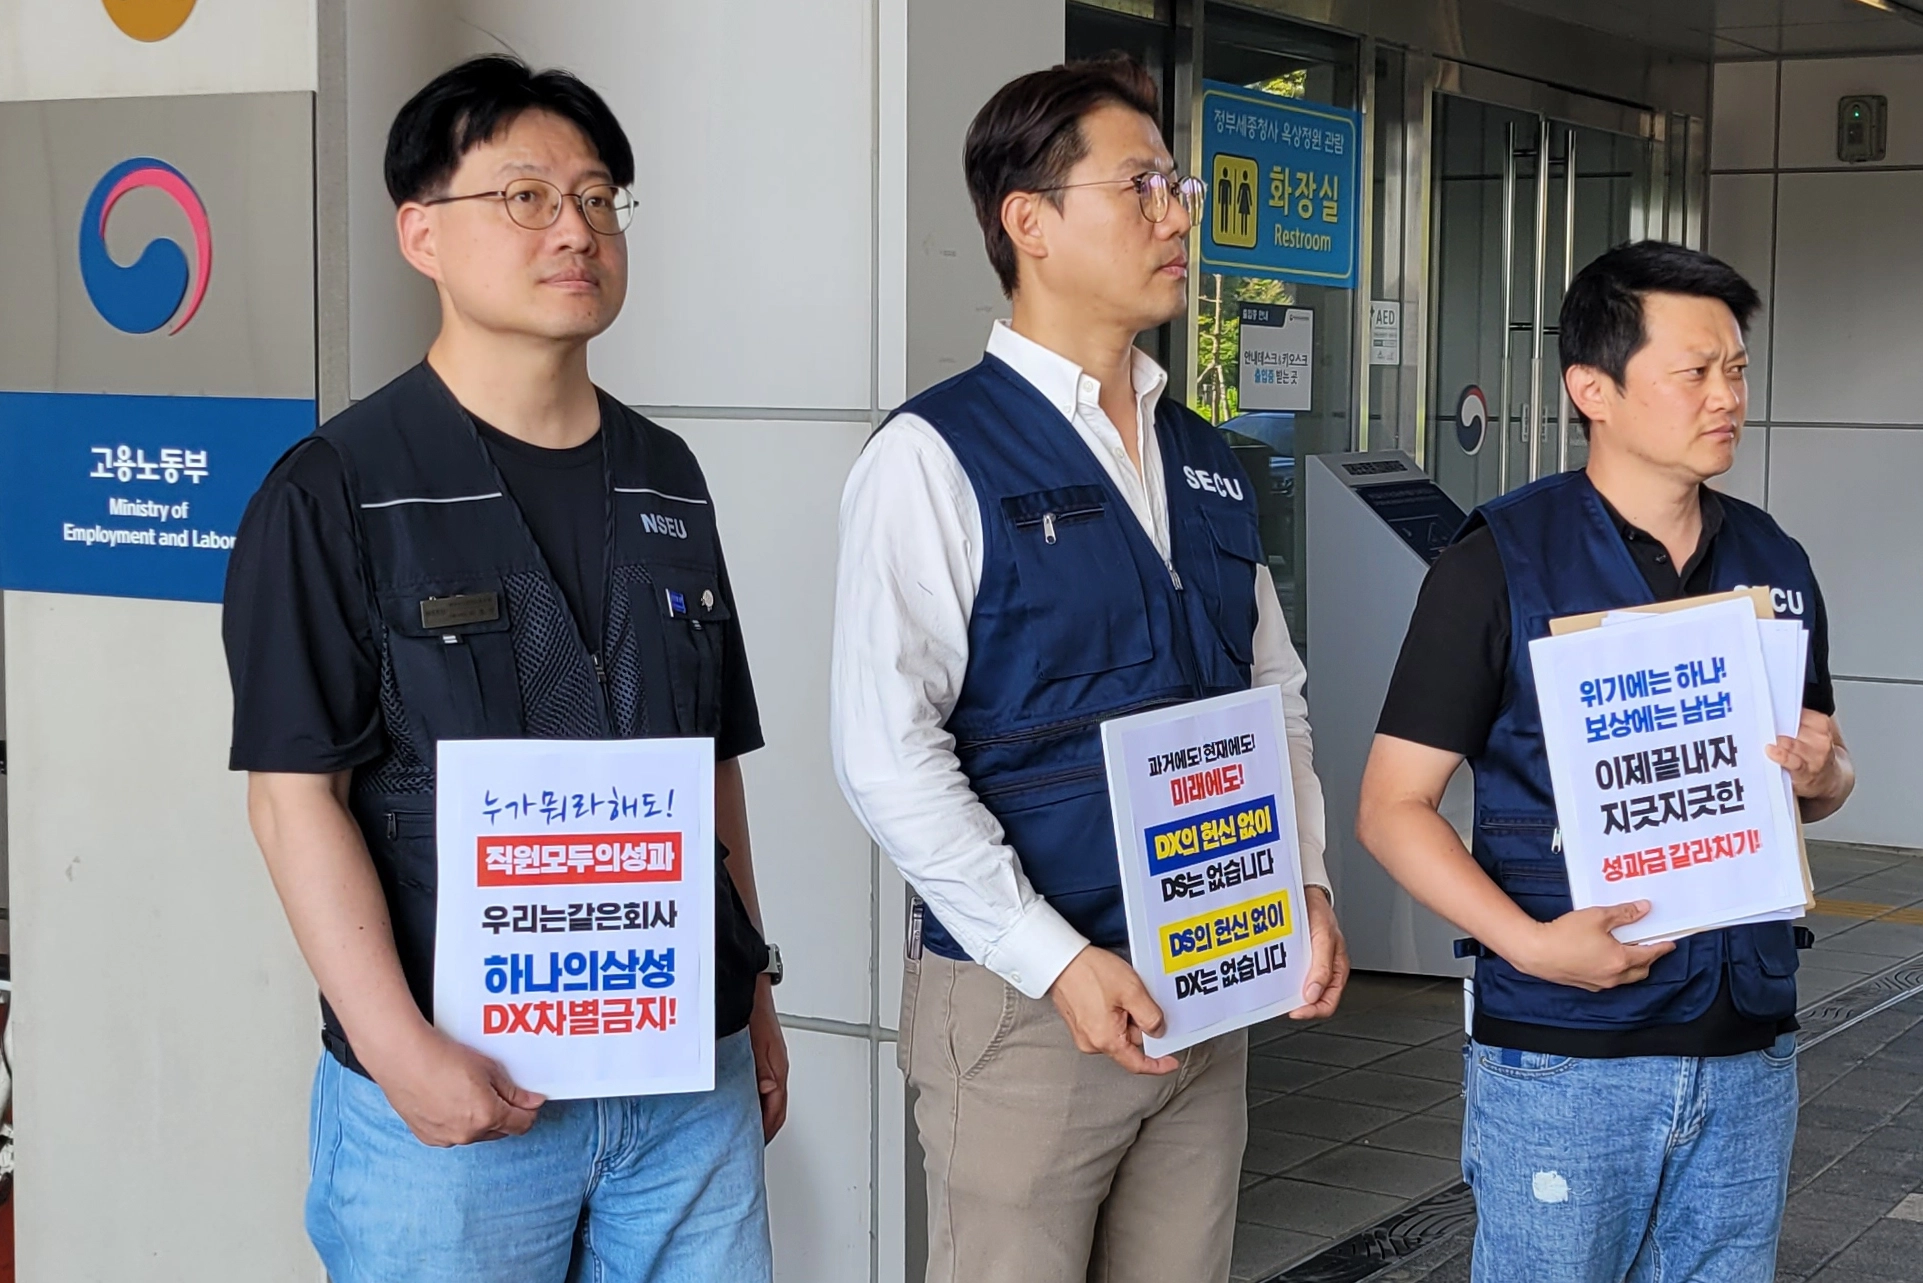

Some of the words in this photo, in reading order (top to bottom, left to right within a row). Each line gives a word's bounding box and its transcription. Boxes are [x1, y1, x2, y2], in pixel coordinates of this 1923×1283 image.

[1213, 108, 1279, 143] 정부세종청사
[1281, 121, 1322, 151] 옥상정원
[1268, 165, 1339, 223] 화장실
[1274, 223, 1332, 252] Restroom
[1376, 309, 1395, 325] AED
[90, 445, 208, 484] 고용노동부
[1183, 465, 1243, 501] SECU
[109, 498, 169, 522] Ministry
[171, 502, 189, 519] of
[640, 513, 688, 539] NSEU
[63, 523, 155, 547] Employment
[159, 529, 189, 547] and
[192, 530, 237, 549] Labor
[1580, 669, 1672, 708] 위기에는
[1674, 656, 1727, 689] 하나!
[1585, 704, 1678, 744] 보상에는
[1680, 691, 1733, 726] 남남!
[1148, 746, 1202, 777] 과거에도!
[1203, 733, 1256, 763] 현재에도!
[1170, 763, 1245, 806] 미래에도!
[1600, 778, 1745, 835] 지긋지긋한
[1154, 825, 1200, 860] DX의
[1200, 815, 1237, 851] 헌신
[1237, 805, 1272, 841] 없이
[1161, 871, 1205, 902] DS는
[1206, 848, 1274, 892] 없습니다
[1602, 847, 1667, 882] 성과금
[1668, 829, 1763, 870] 갈라치기!
[1169, 922, 1212, 958] DS의
[1214, 911, 1250, 947] 헌신
[1251, 900, 1285, 936] 없이
[483, 947, 676, 995] 하나의삼성
[1175, 968, 1218, 1000] DX는
[1220, 941, 1287, 988] 없습니다
[482, 997, 677, 1036] DX차별금지!
